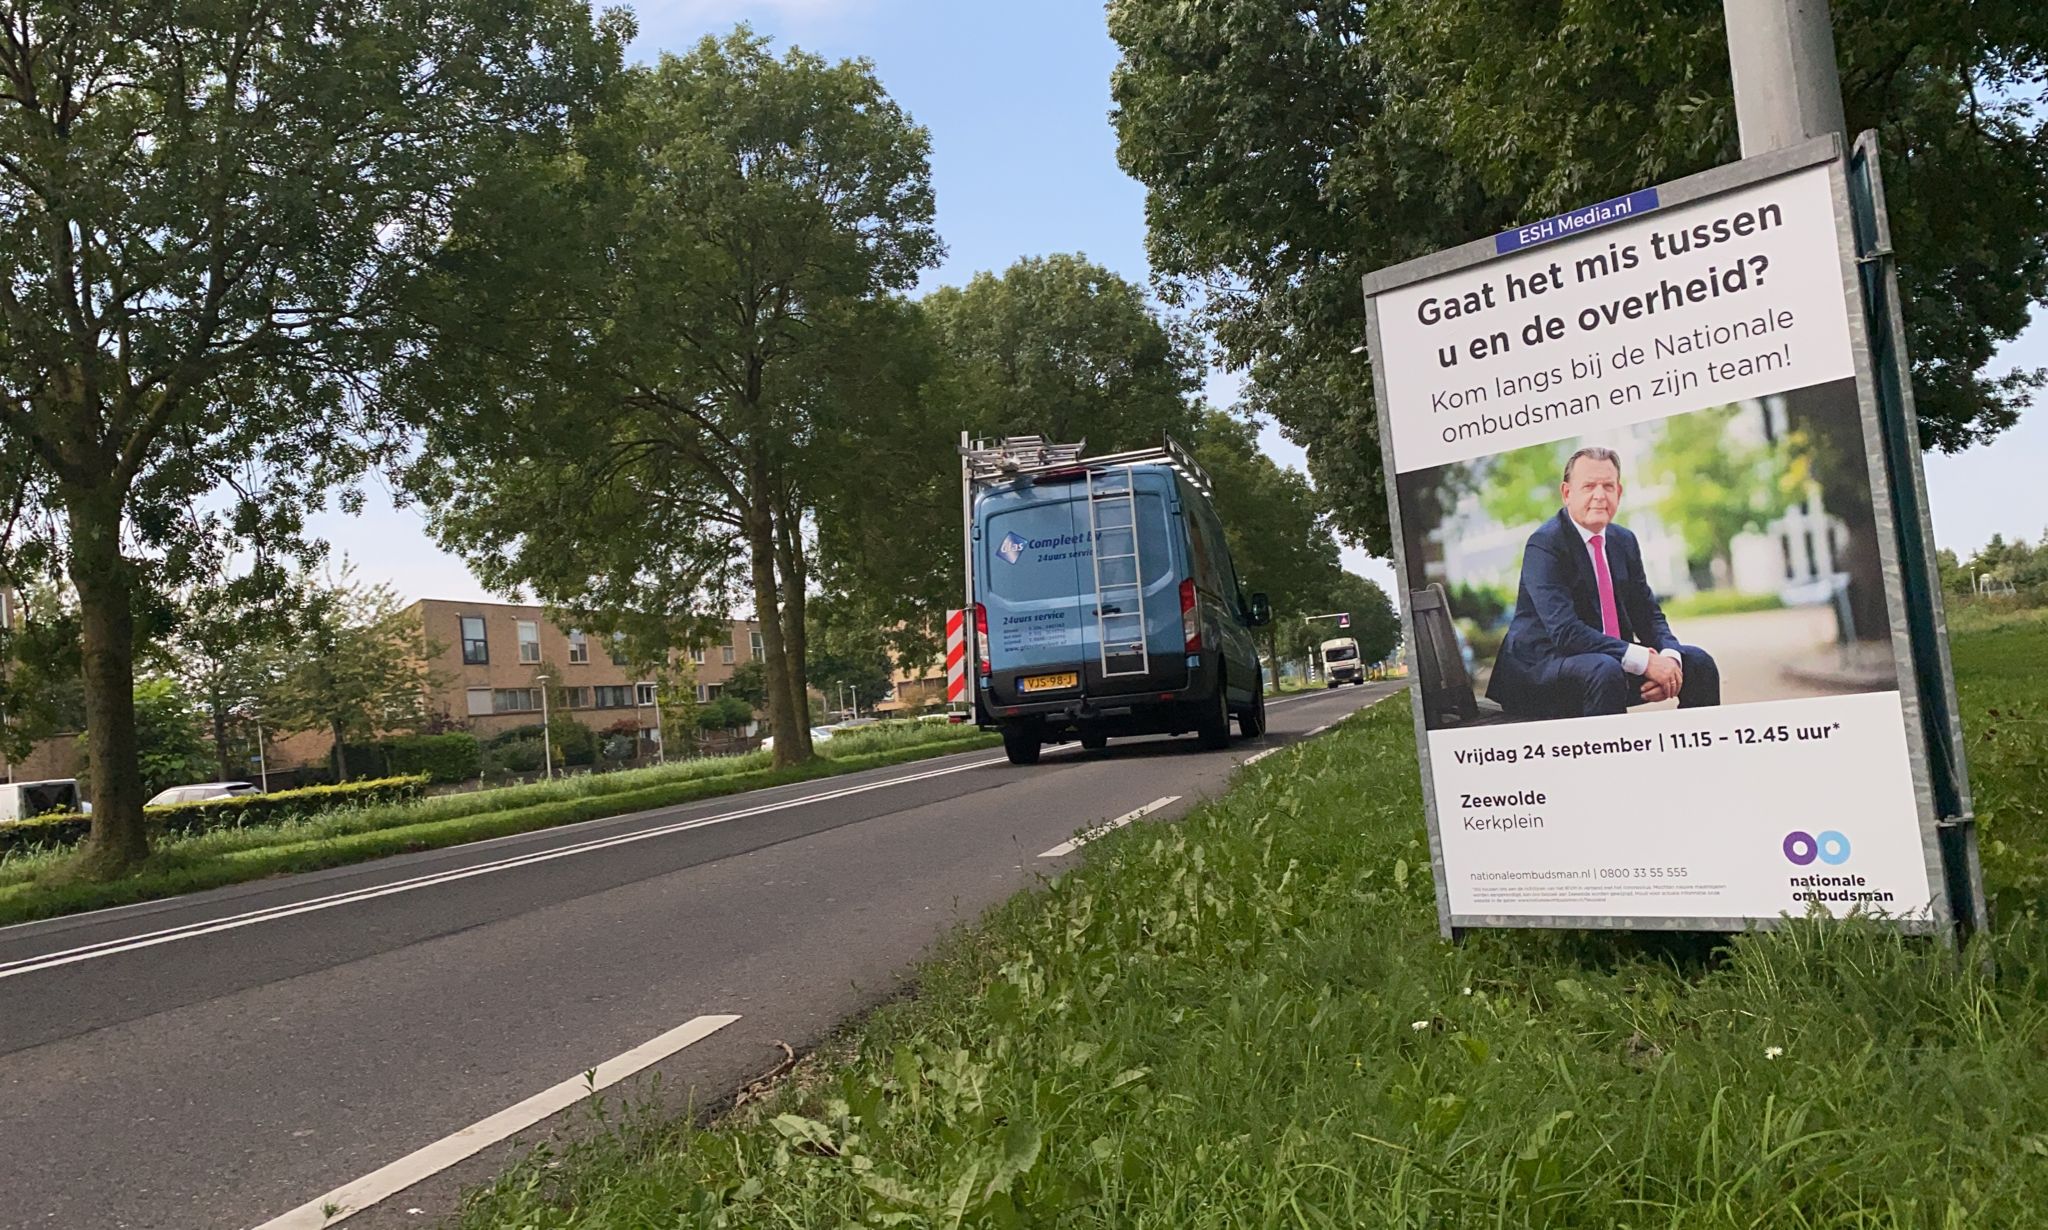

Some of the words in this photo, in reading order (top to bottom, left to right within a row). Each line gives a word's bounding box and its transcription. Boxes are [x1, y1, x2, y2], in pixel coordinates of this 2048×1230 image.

[1519, 222, 1553, 244] ESH
[1557, 198, 1632, 232] Media.nl
[1417, 282, 1496, 326] Gaat
[1506, 262, 1564, 303] het
[1576, 242, 1639, 283] mis
[1650, 203, 1783, 260] tussen
[1438, 345, 1458, 368] u
[1469, 331, 1511, 360] en
[1521, 314, 1566, 346] de
[1578, 254, 1770, 331] overheid?
[1431, 386, 1488, 413] Kom
[1495, 371, 1563, 399] langs
[1570, 353, 1603, 381] bij
[1610, 345, 1646, 370] de
[1654, 308, 1794, 360] Nationale
[1442, 394, 1601, 443] ombudsman
[1609, 384, 1641, 406] en
[1651, 370, 1698, 398] zijn
[1707, 343, 1792, 384] team!
[1028, 532, 1084, 550] Compleet
[1037, 551, 1067, 563] 24uurs
[1003, 615, 1032, 625] 24uurs
[1034, 611, 1065, 622] service
[1027, 674, 1073, 689] VJS-98-J
[1454, 746, 1519, 765] Vrijdag
[1523, 743, 1547, 760] 24
[1551, 737, 1653, 759] september
[1670, 731, 1713, 750] 11.15
[1734, 725, 1790, 745] 12.45
[1460, 790, 1547, 809] Zeewolde
[1463, 813, 1545, 832] Kerkplein
[1470, 868, 1591, 881] nationaleombudsman.nl
[1599, 868, 1630, 879] 0800
[1633, 867, 1647, 878] 33
[1649, 867, 1664, 878] 55
[1666, 866, 1688, 878] 555
[1790, 874, 1866, 887] nationale
[1792, 889, 1895, 902] ombudsman
